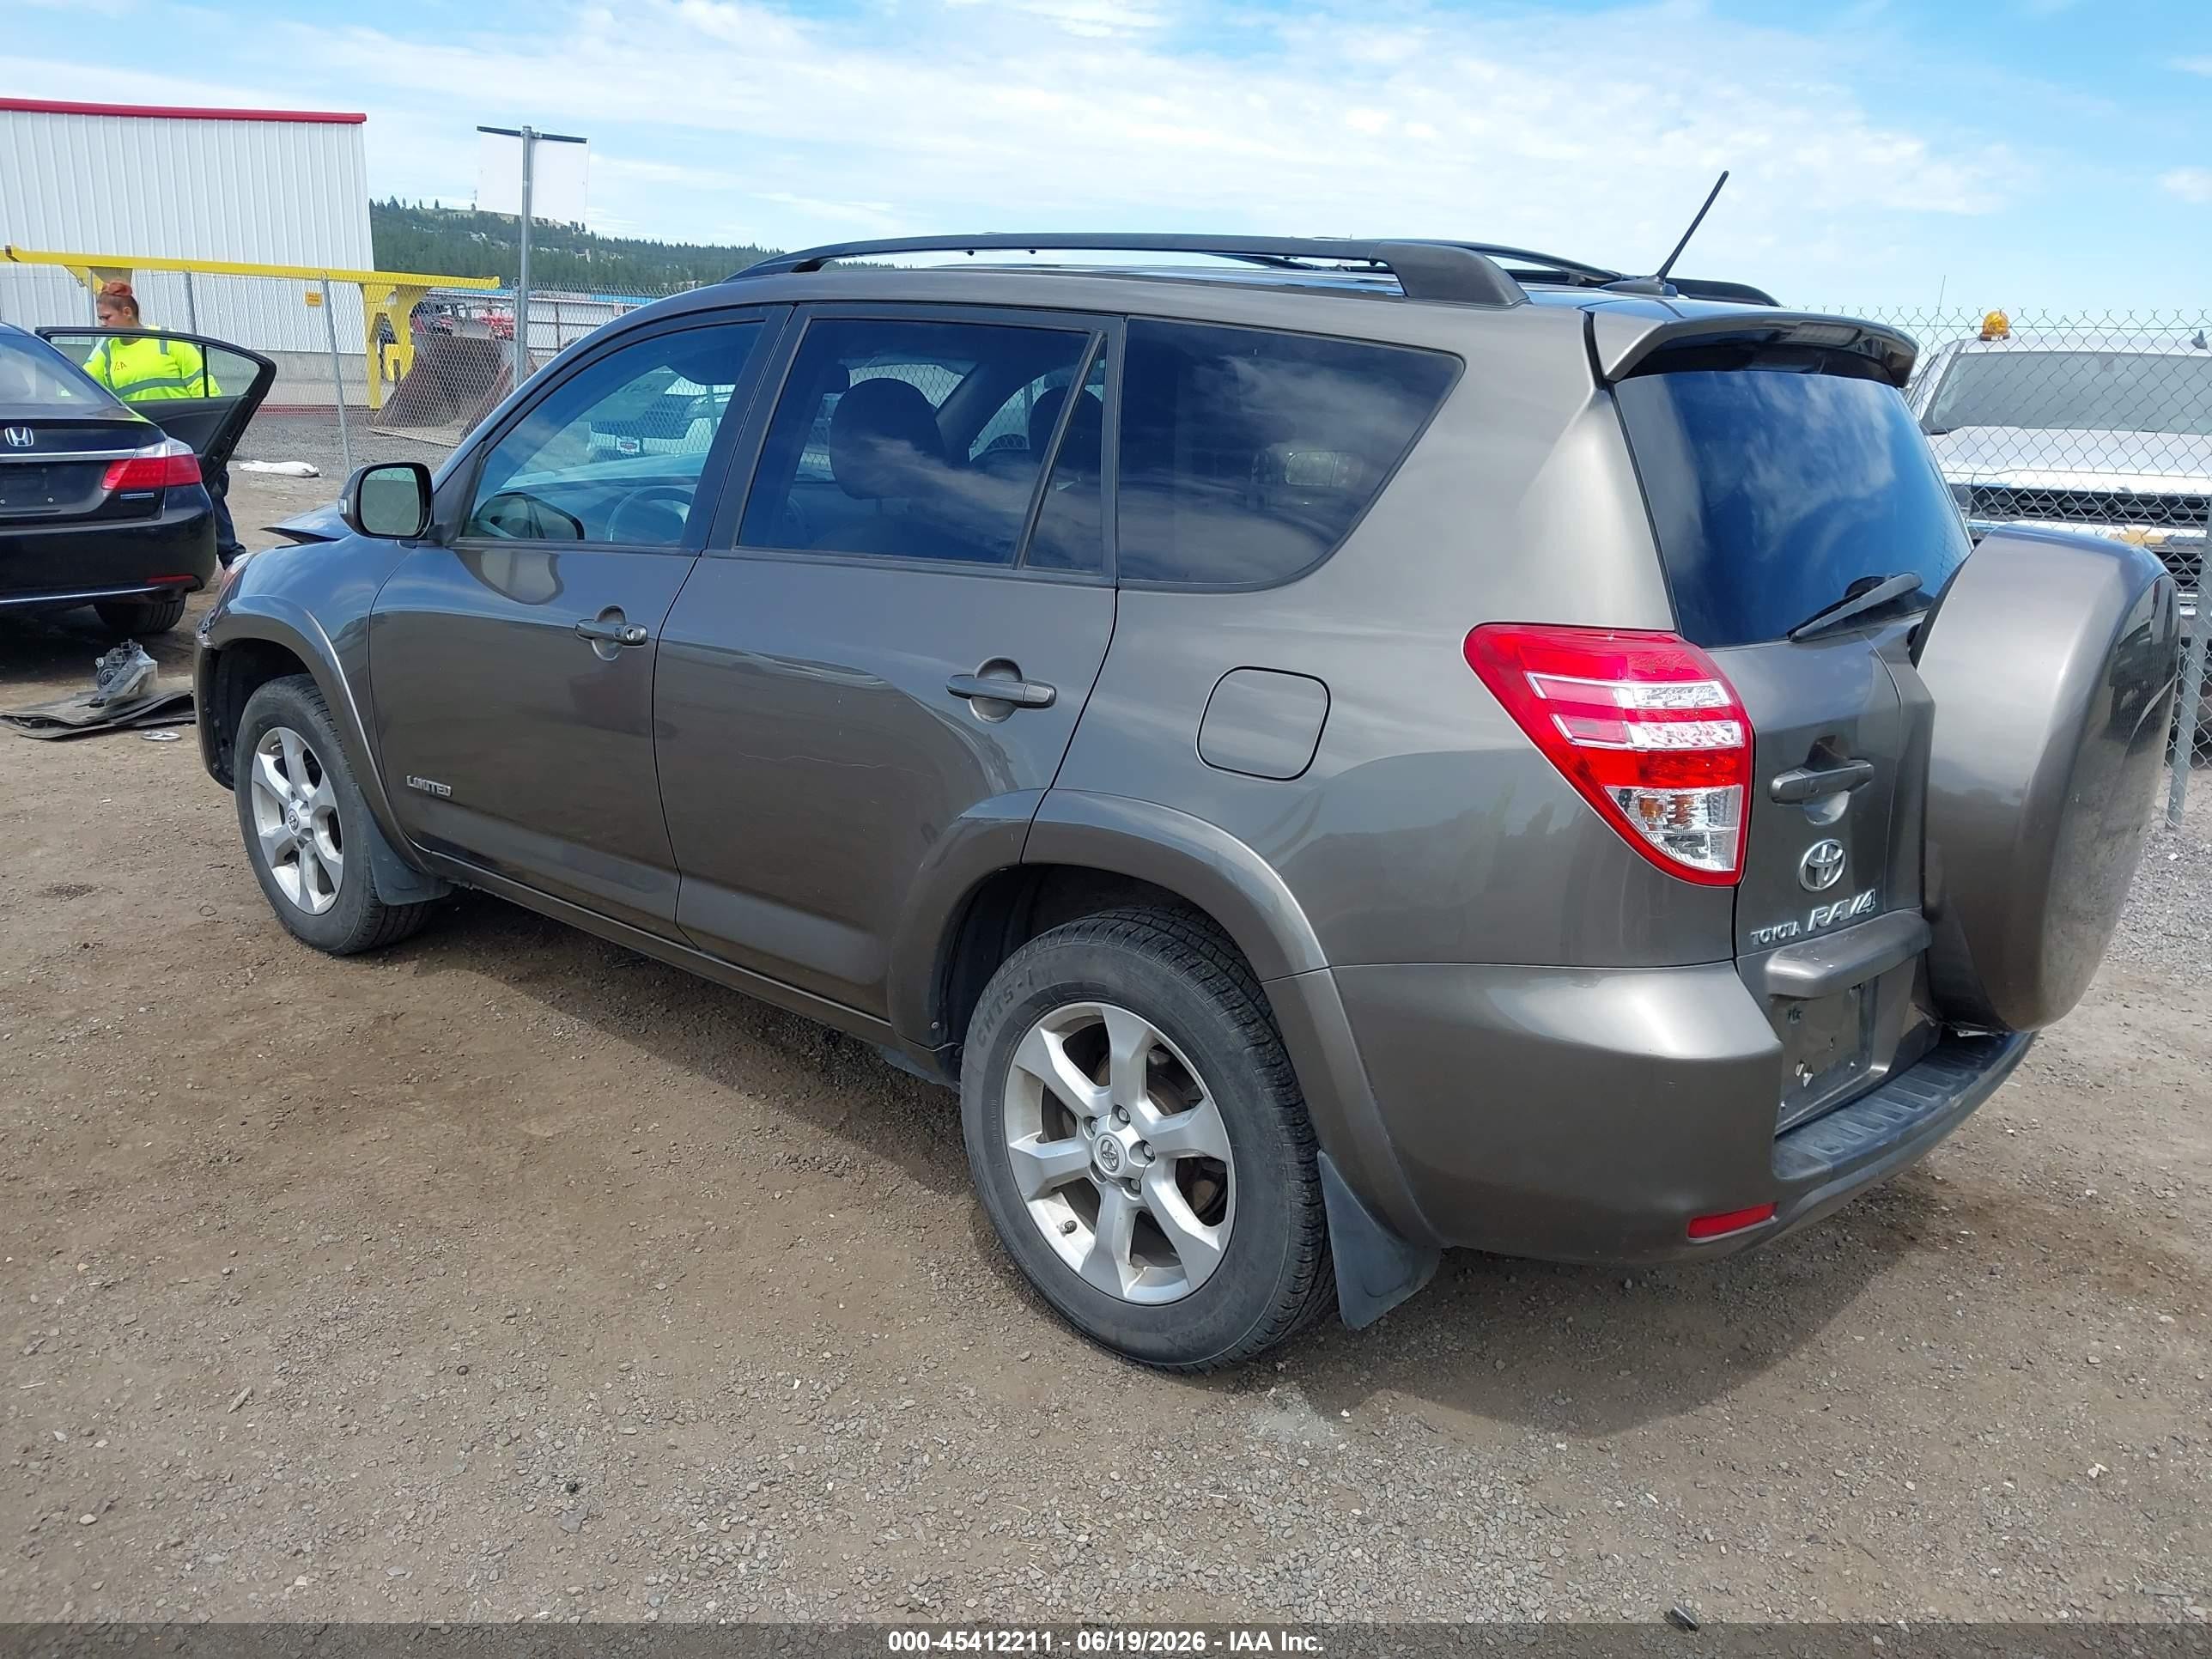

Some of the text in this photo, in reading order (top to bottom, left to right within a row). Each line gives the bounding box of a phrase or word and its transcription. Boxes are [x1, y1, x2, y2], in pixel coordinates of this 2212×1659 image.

[406, 775, 452, 798] LIMITED
[1750, 888, 1876, 945] TOYOTA RAV4
